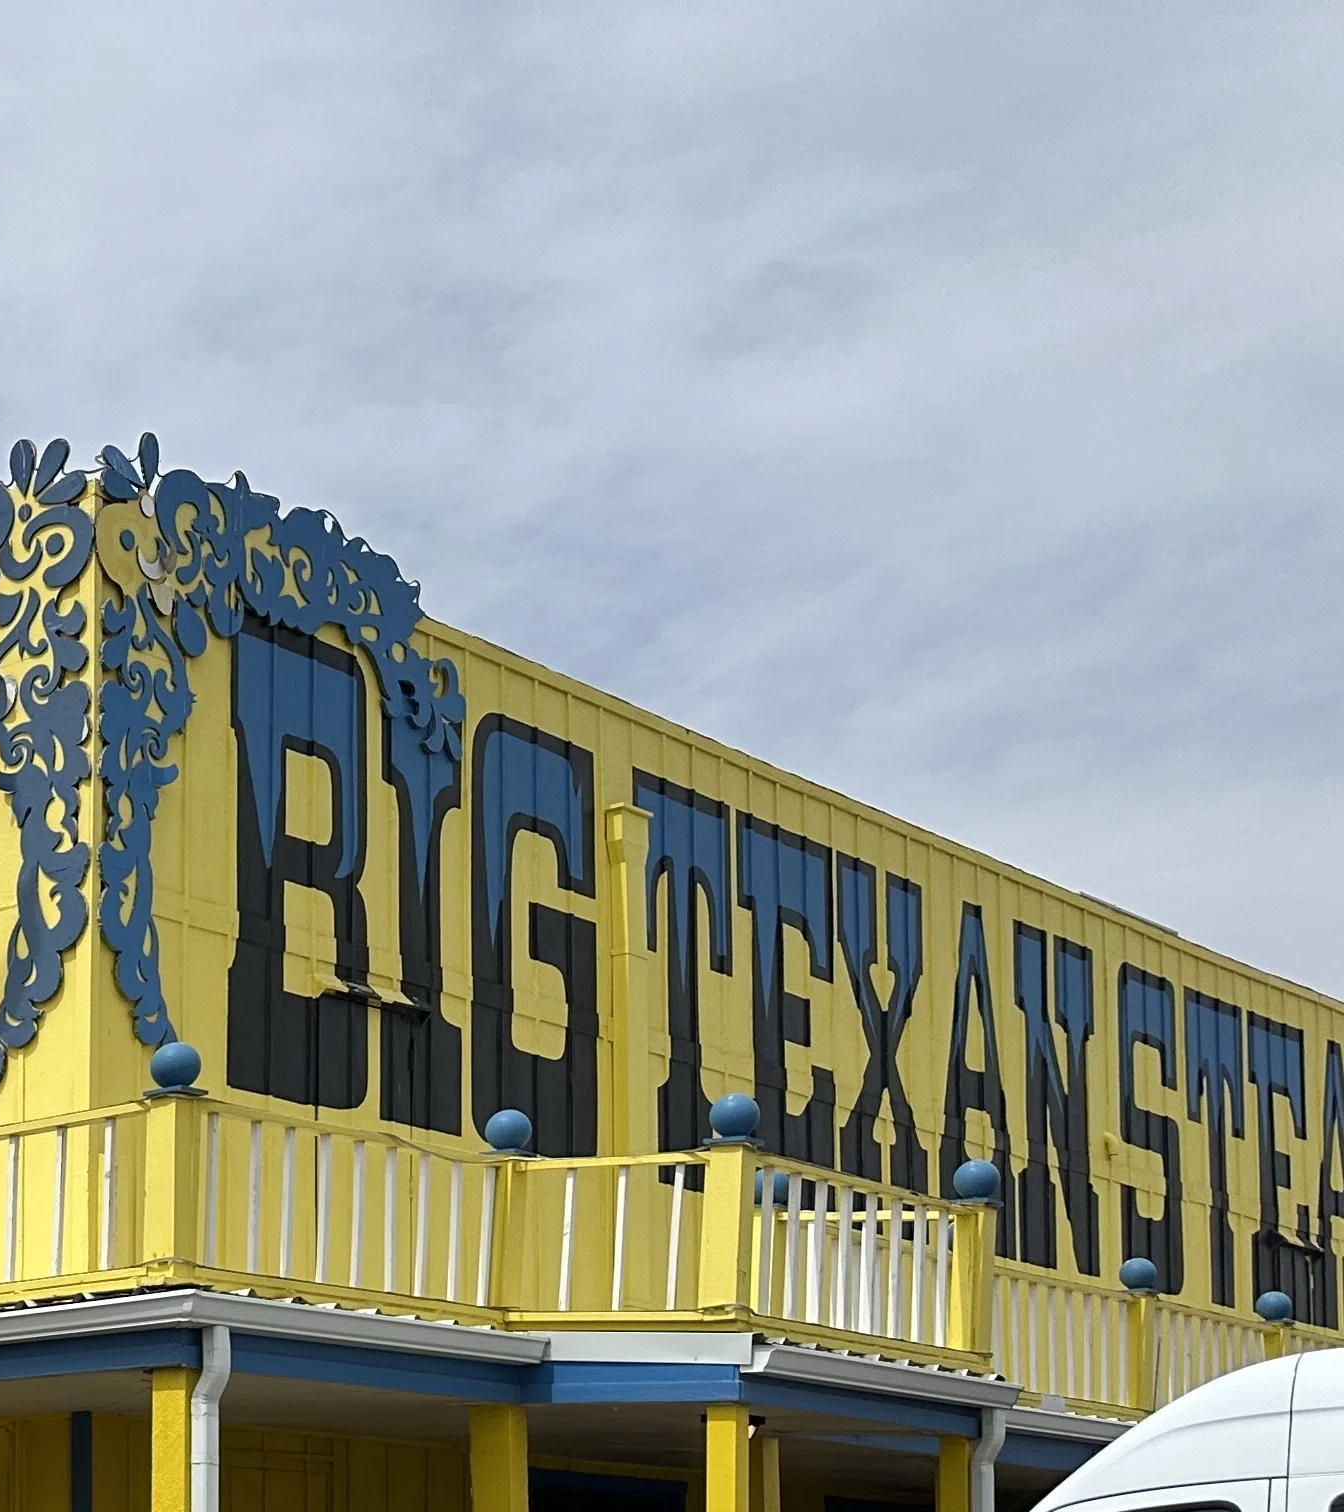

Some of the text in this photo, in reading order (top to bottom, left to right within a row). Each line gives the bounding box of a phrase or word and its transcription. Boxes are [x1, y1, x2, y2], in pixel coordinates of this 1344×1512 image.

[227, 610, 1344, 1331] BIG TEXAN STEA
